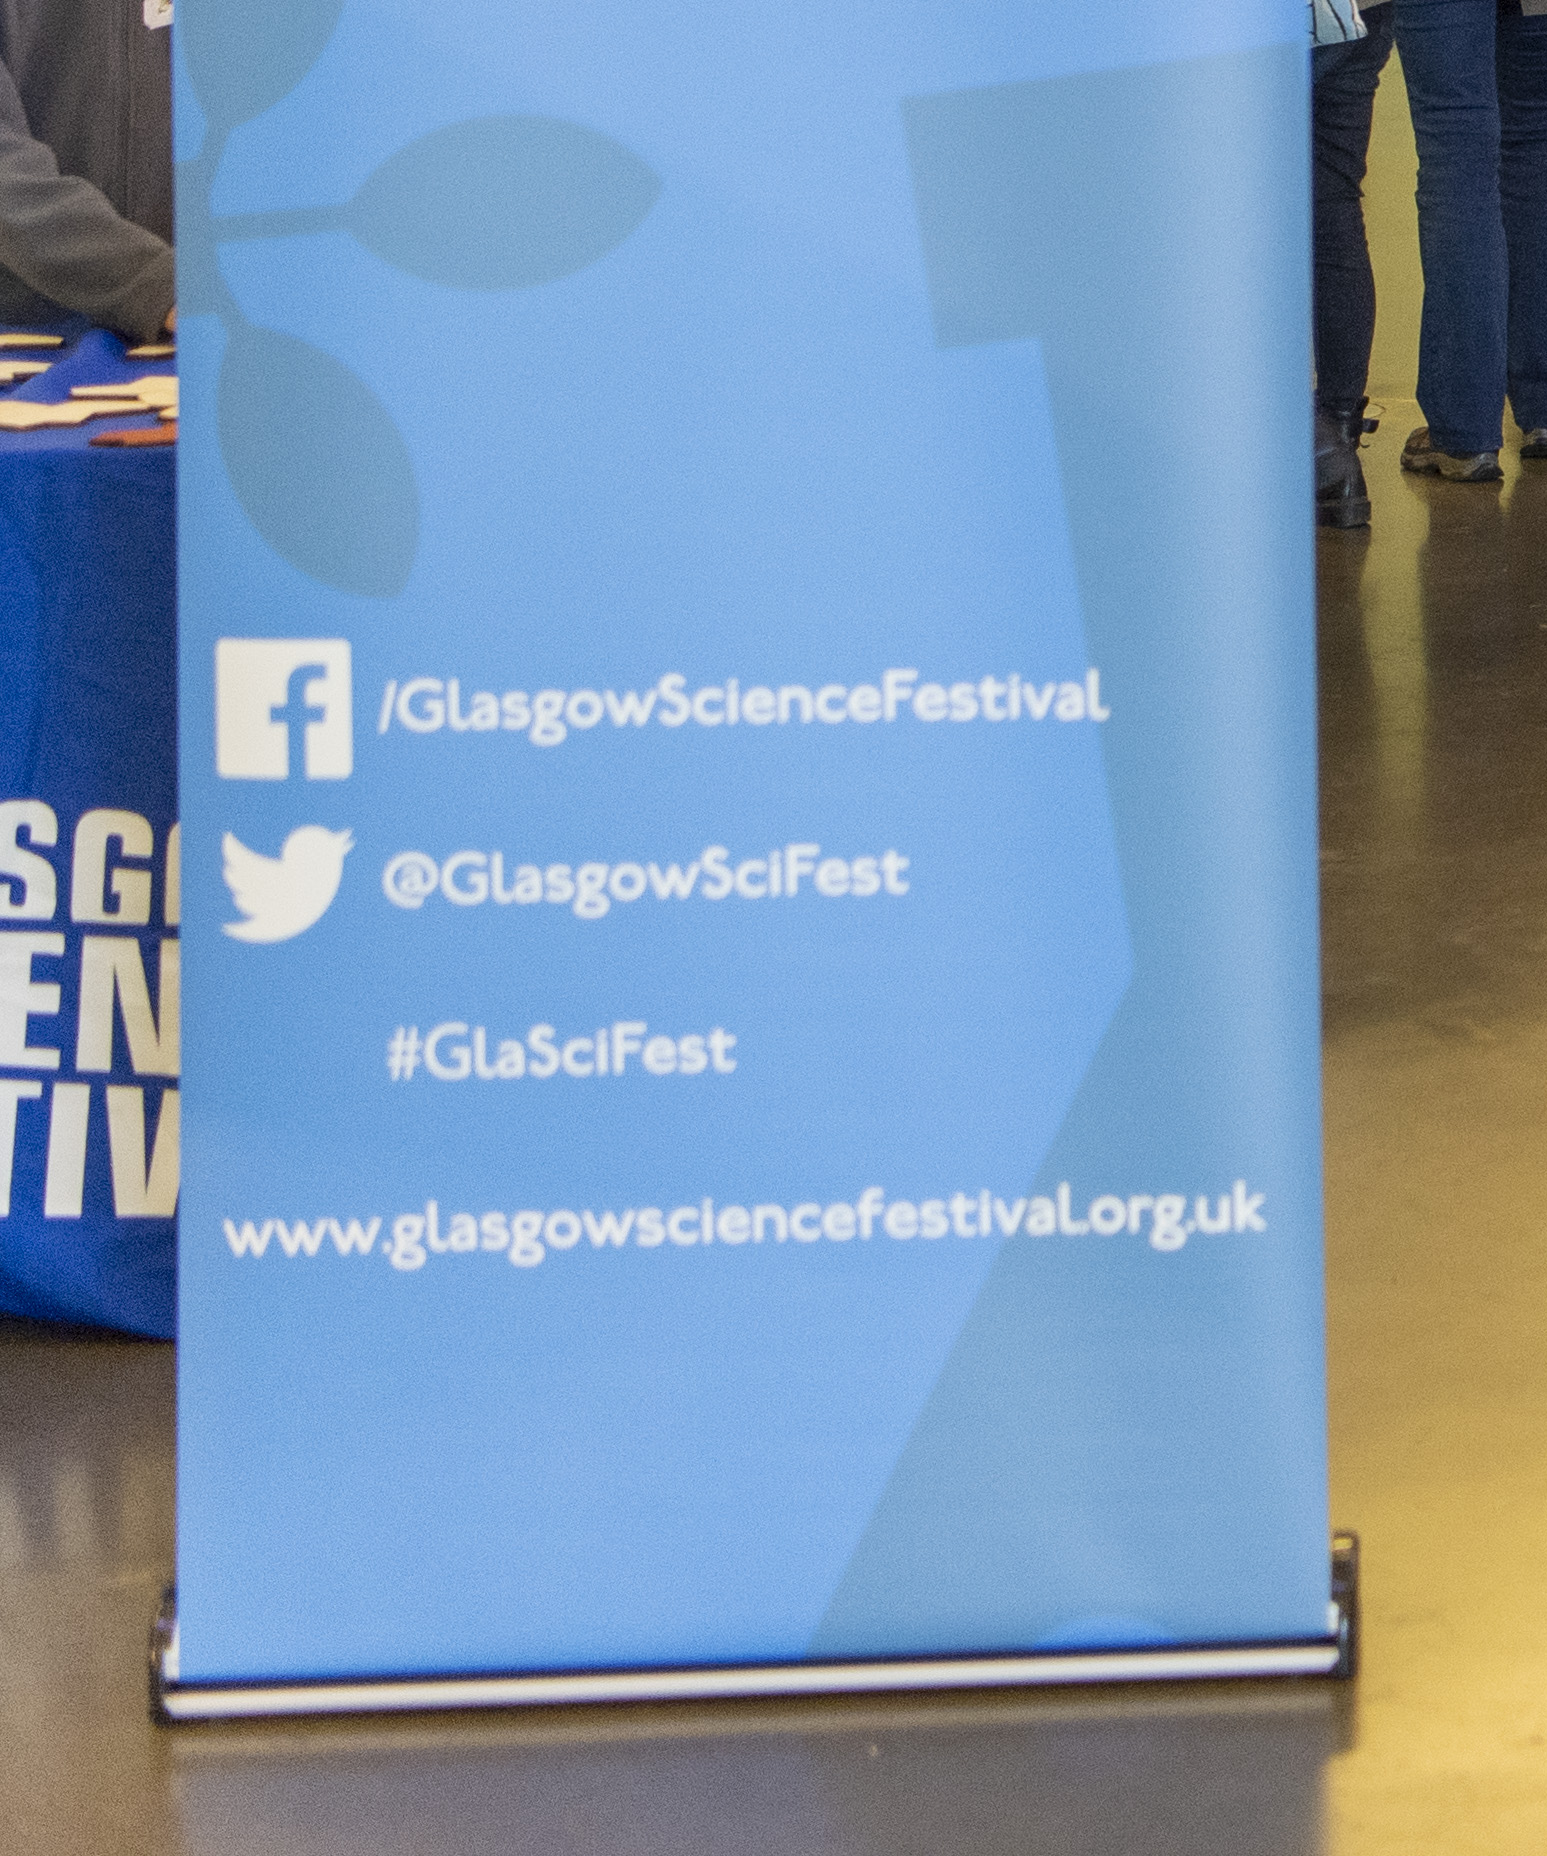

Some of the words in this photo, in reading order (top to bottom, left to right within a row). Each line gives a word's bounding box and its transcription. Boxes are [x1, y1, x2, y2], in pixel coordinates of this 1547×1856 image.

[377, 668, 1112, 747] /GlasgowScienceFestival
[380, 844, 913, 919] @GlasgowSciFest
[386, 1021, 740, 1082] #GlaSciFest
[221, 1178, 1270, 1271] www.glasgowsciencefestival.org.uk
